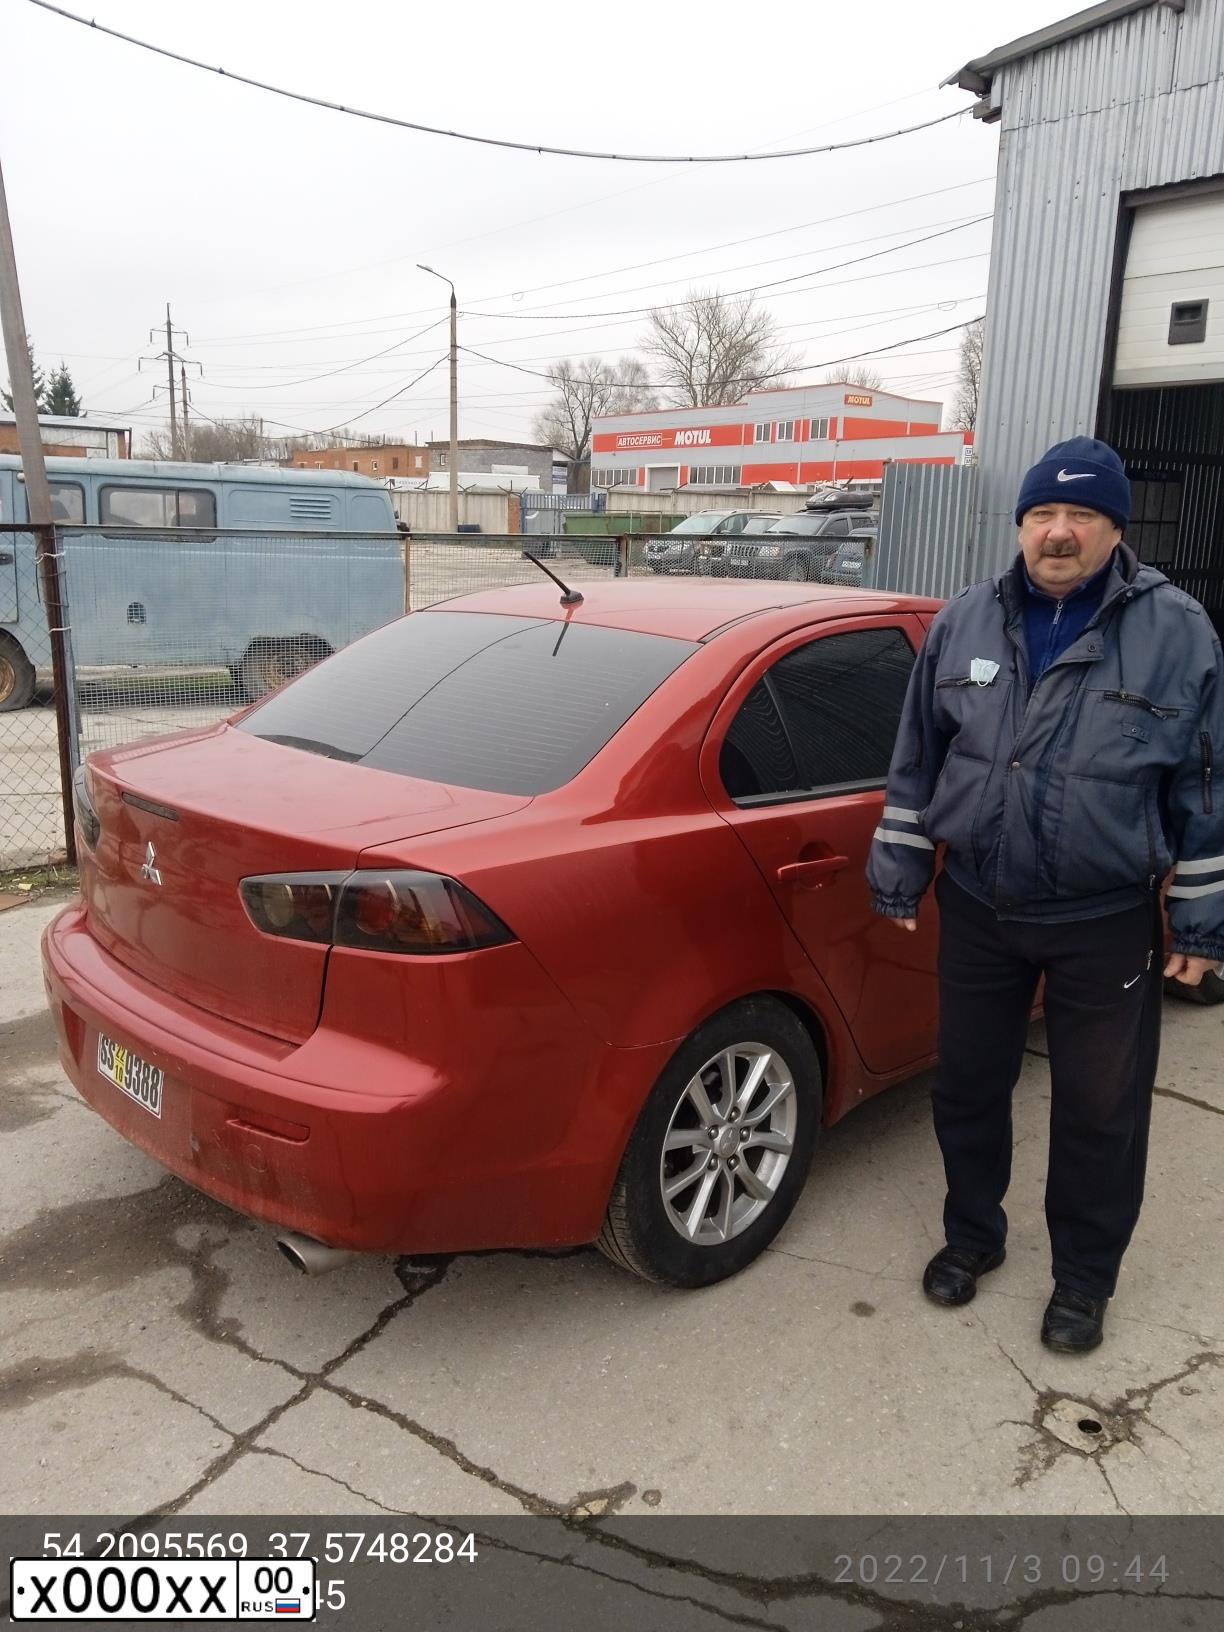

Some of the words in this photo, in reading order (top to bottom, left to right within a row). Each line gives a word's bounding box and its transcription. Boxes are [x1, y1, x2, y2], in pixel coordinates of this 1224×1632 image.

[848, 395, 870, 405] MOTUL
[617, 434, 661, 446] АВТОСЕРВИС
[674, 429, 711, 446] MOTUL
[124, 1054, 160, 1108] 9388
